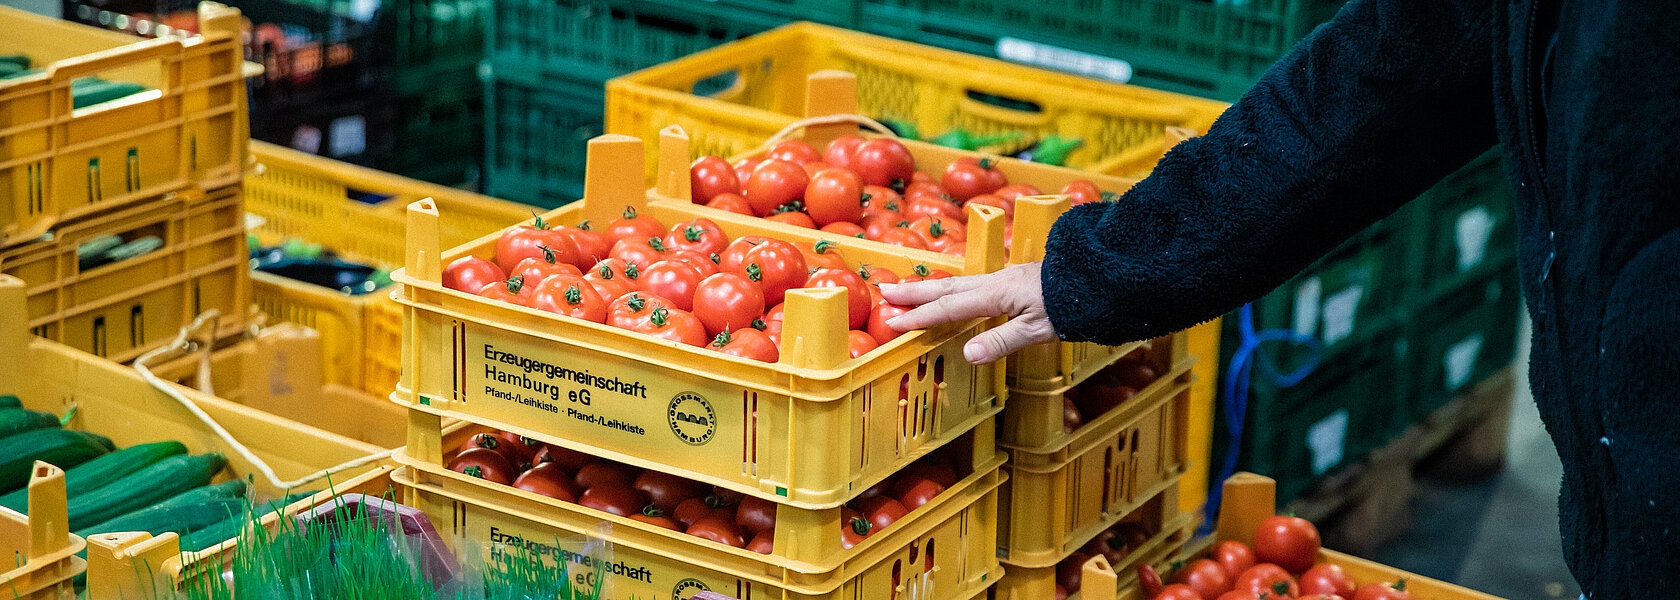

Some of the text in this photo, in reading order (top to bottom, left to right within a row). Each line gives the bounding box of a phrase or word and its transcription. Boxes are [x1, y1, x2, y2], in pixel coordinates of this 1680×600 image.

[484, 344, 647, 399] Erzeugergemeinschaft
[485, 364, 591, 406] Hamburg eG
[485, 386, 645, 435] Pfand-/Leihkiste Pfand-/Leihkiste
